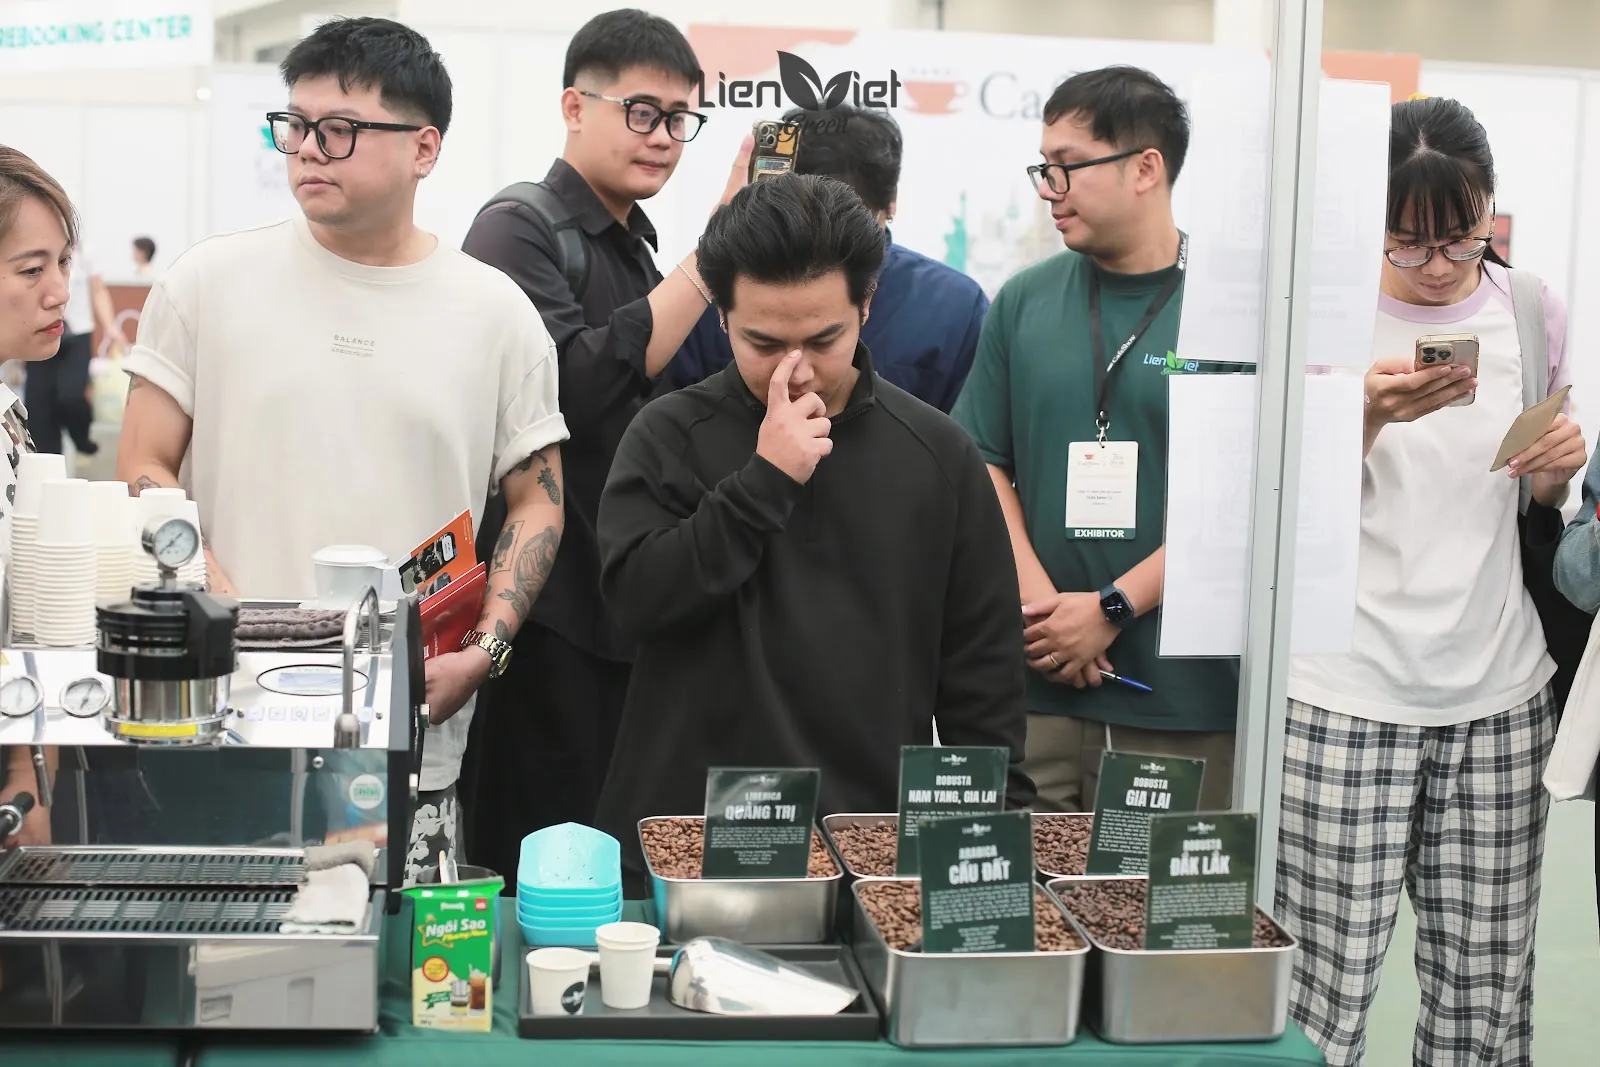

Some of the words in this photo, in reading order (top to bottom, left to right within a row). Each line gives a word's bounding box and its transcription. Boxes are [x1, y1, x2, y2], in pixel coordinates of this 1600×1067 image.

[333, 334, 375, 346] BALANCE
[1074, 529, 1125, 538] EXHIBITOR
[935, 775, 972, 786] ROBUSTA
[1133, 777, 1168, 790] ROBUSTA
[908, 790, 932, 803] NAM
[933, 790, 961, 805] YANG,
[963, 790, 980, 803] GIA
[981, 790, 998, 803] LAI
[1125, 789, 1147, 807] GIA
[1150, 792, 1171, 809] LAI
[775, 805, 797, 822] TRỊ
[460, 918, 487, 932] Sao
